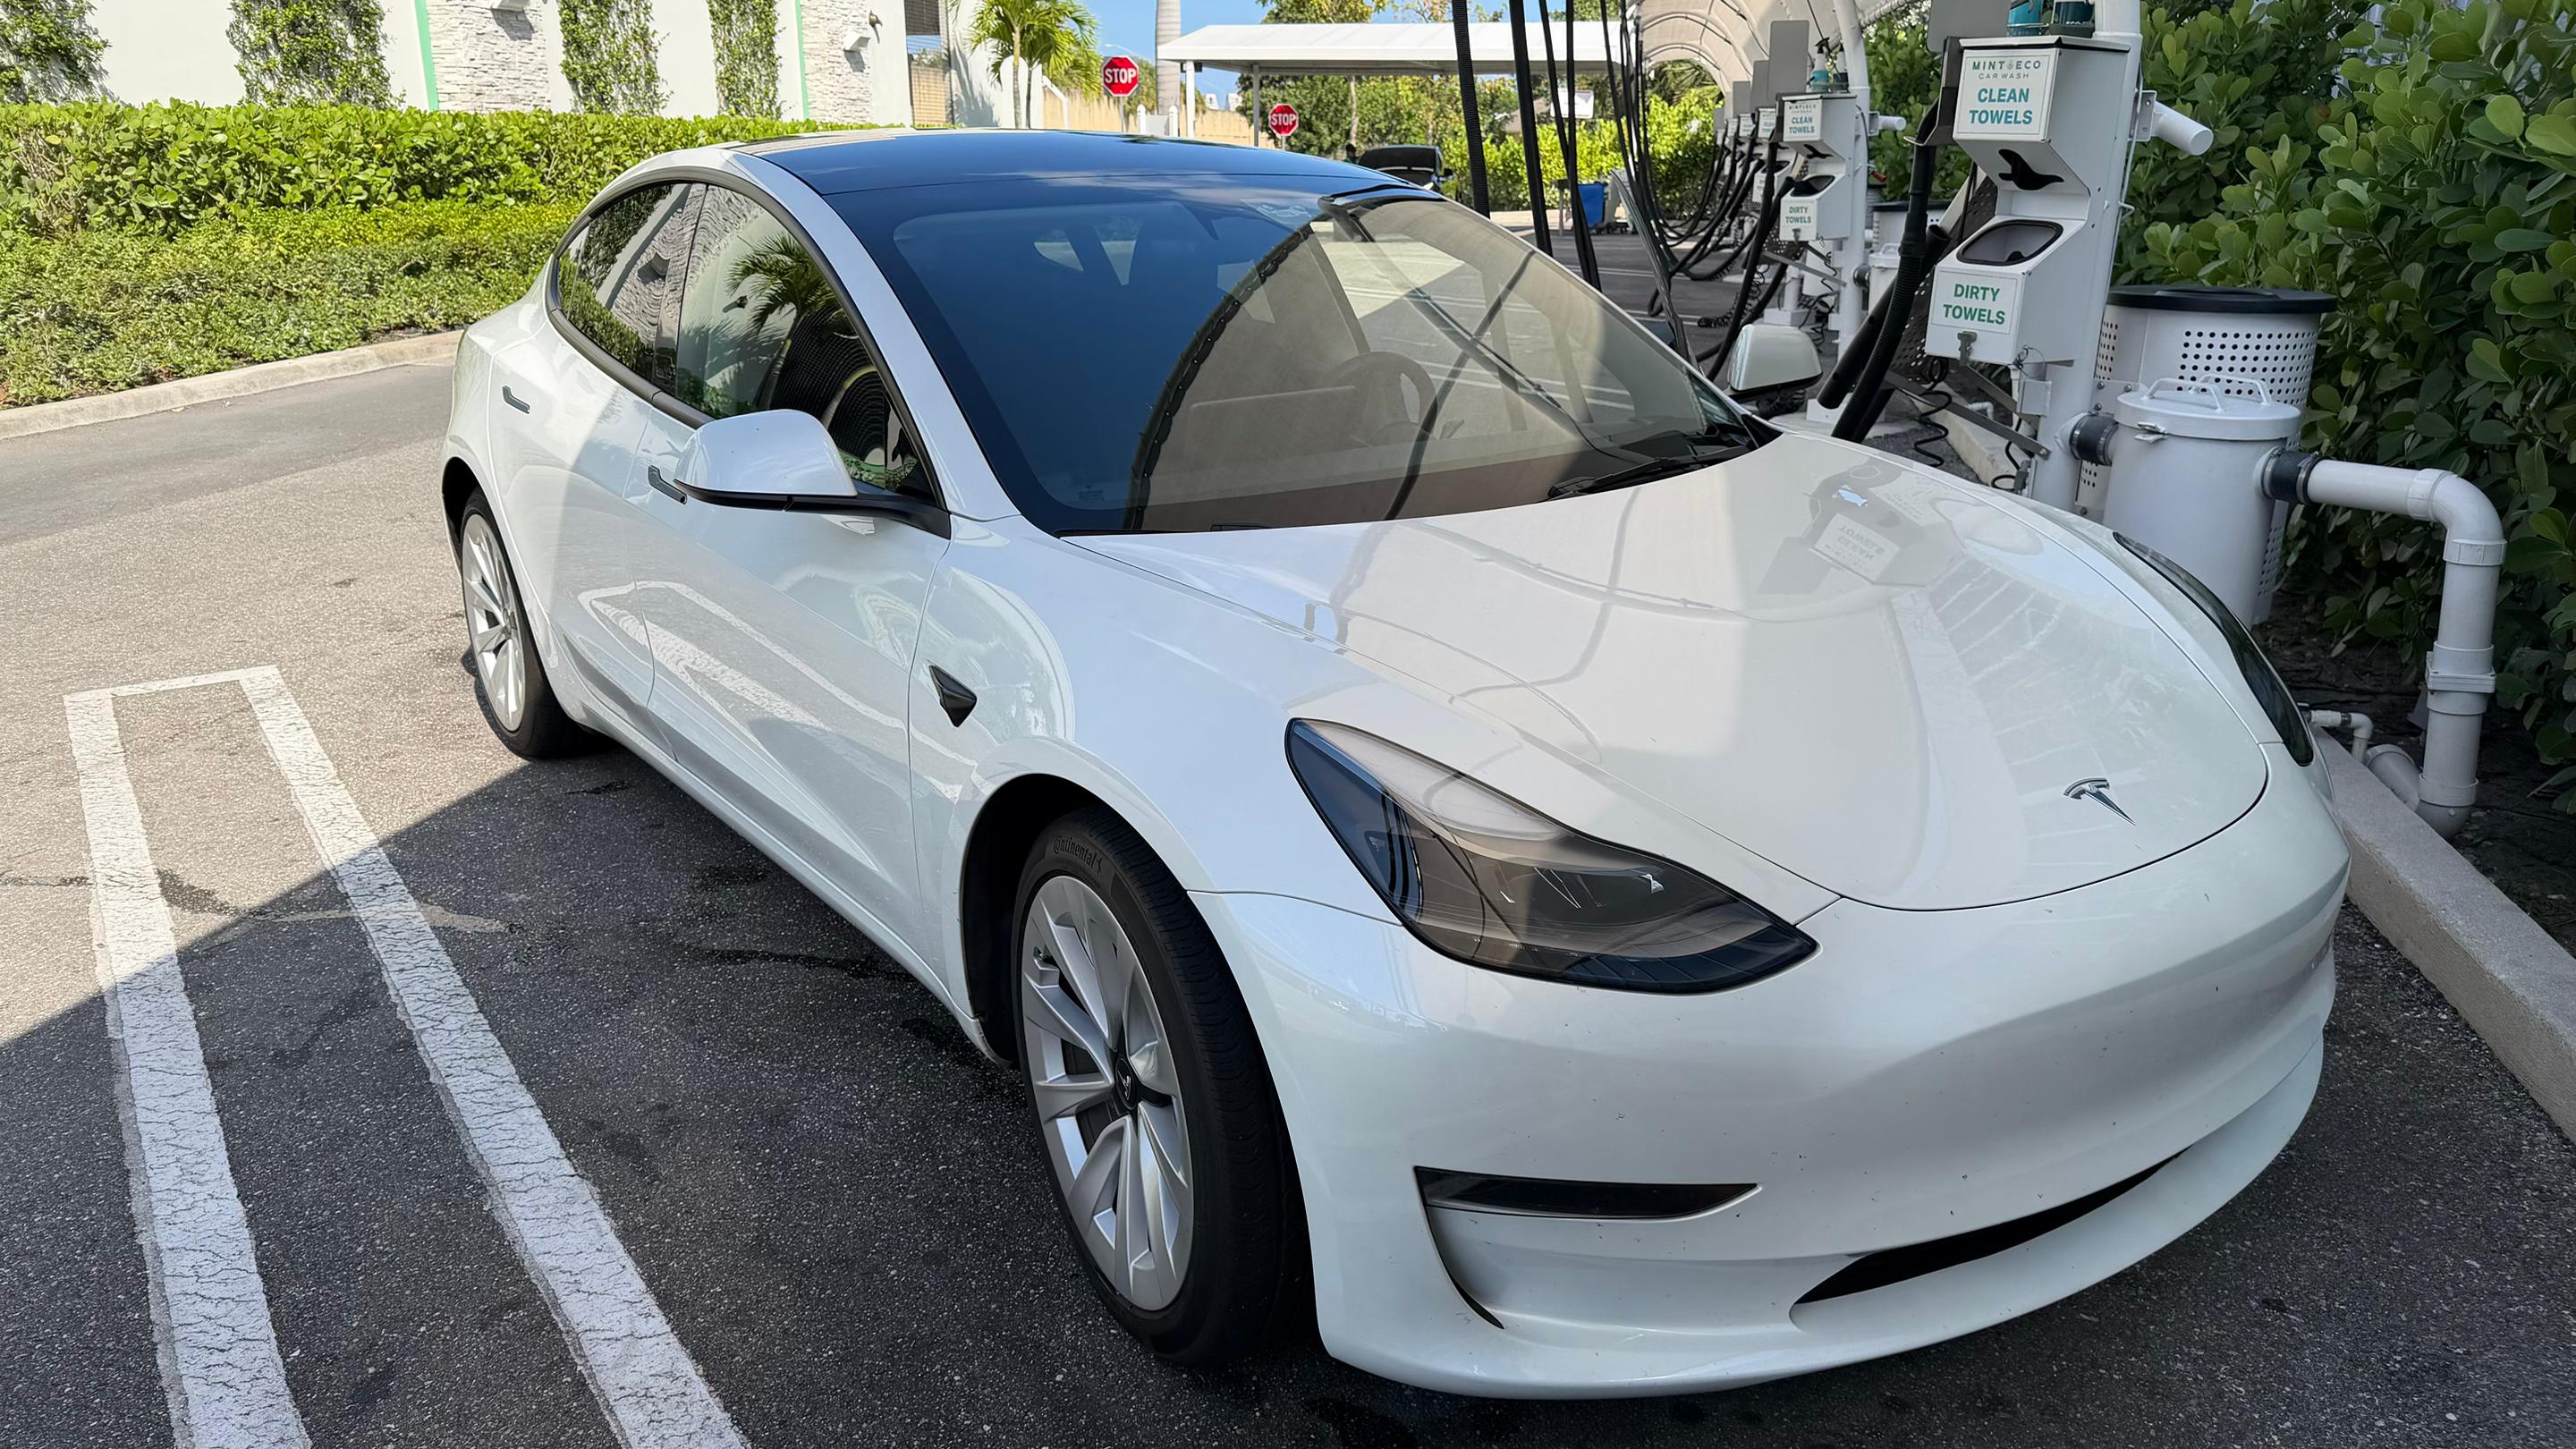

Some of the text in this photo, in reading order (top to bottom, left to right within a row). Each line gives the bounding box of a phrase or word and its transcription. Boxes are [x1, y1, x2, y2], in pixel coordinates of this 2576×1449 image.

[1972, 60, 2041, 70] MINT ECO
[1105, 68, 1137, 83] STOP
[1978, 88, 2029, 103] CLEAN
[1271, 114, 1297, 126] STOP
[1791, 116, 1813, 124] CLEAN
[1969, 109, 2033, 124] TOWELS
[1789, 126, 1815, 134] TOWELS
[1785, 216, 1812, 224] TOWELS
[1953, 284, 2000, 301] DIRTY
[1943, 304, 2005, 325] TOWELS
[1053, 836, 1097, 868] Continental
